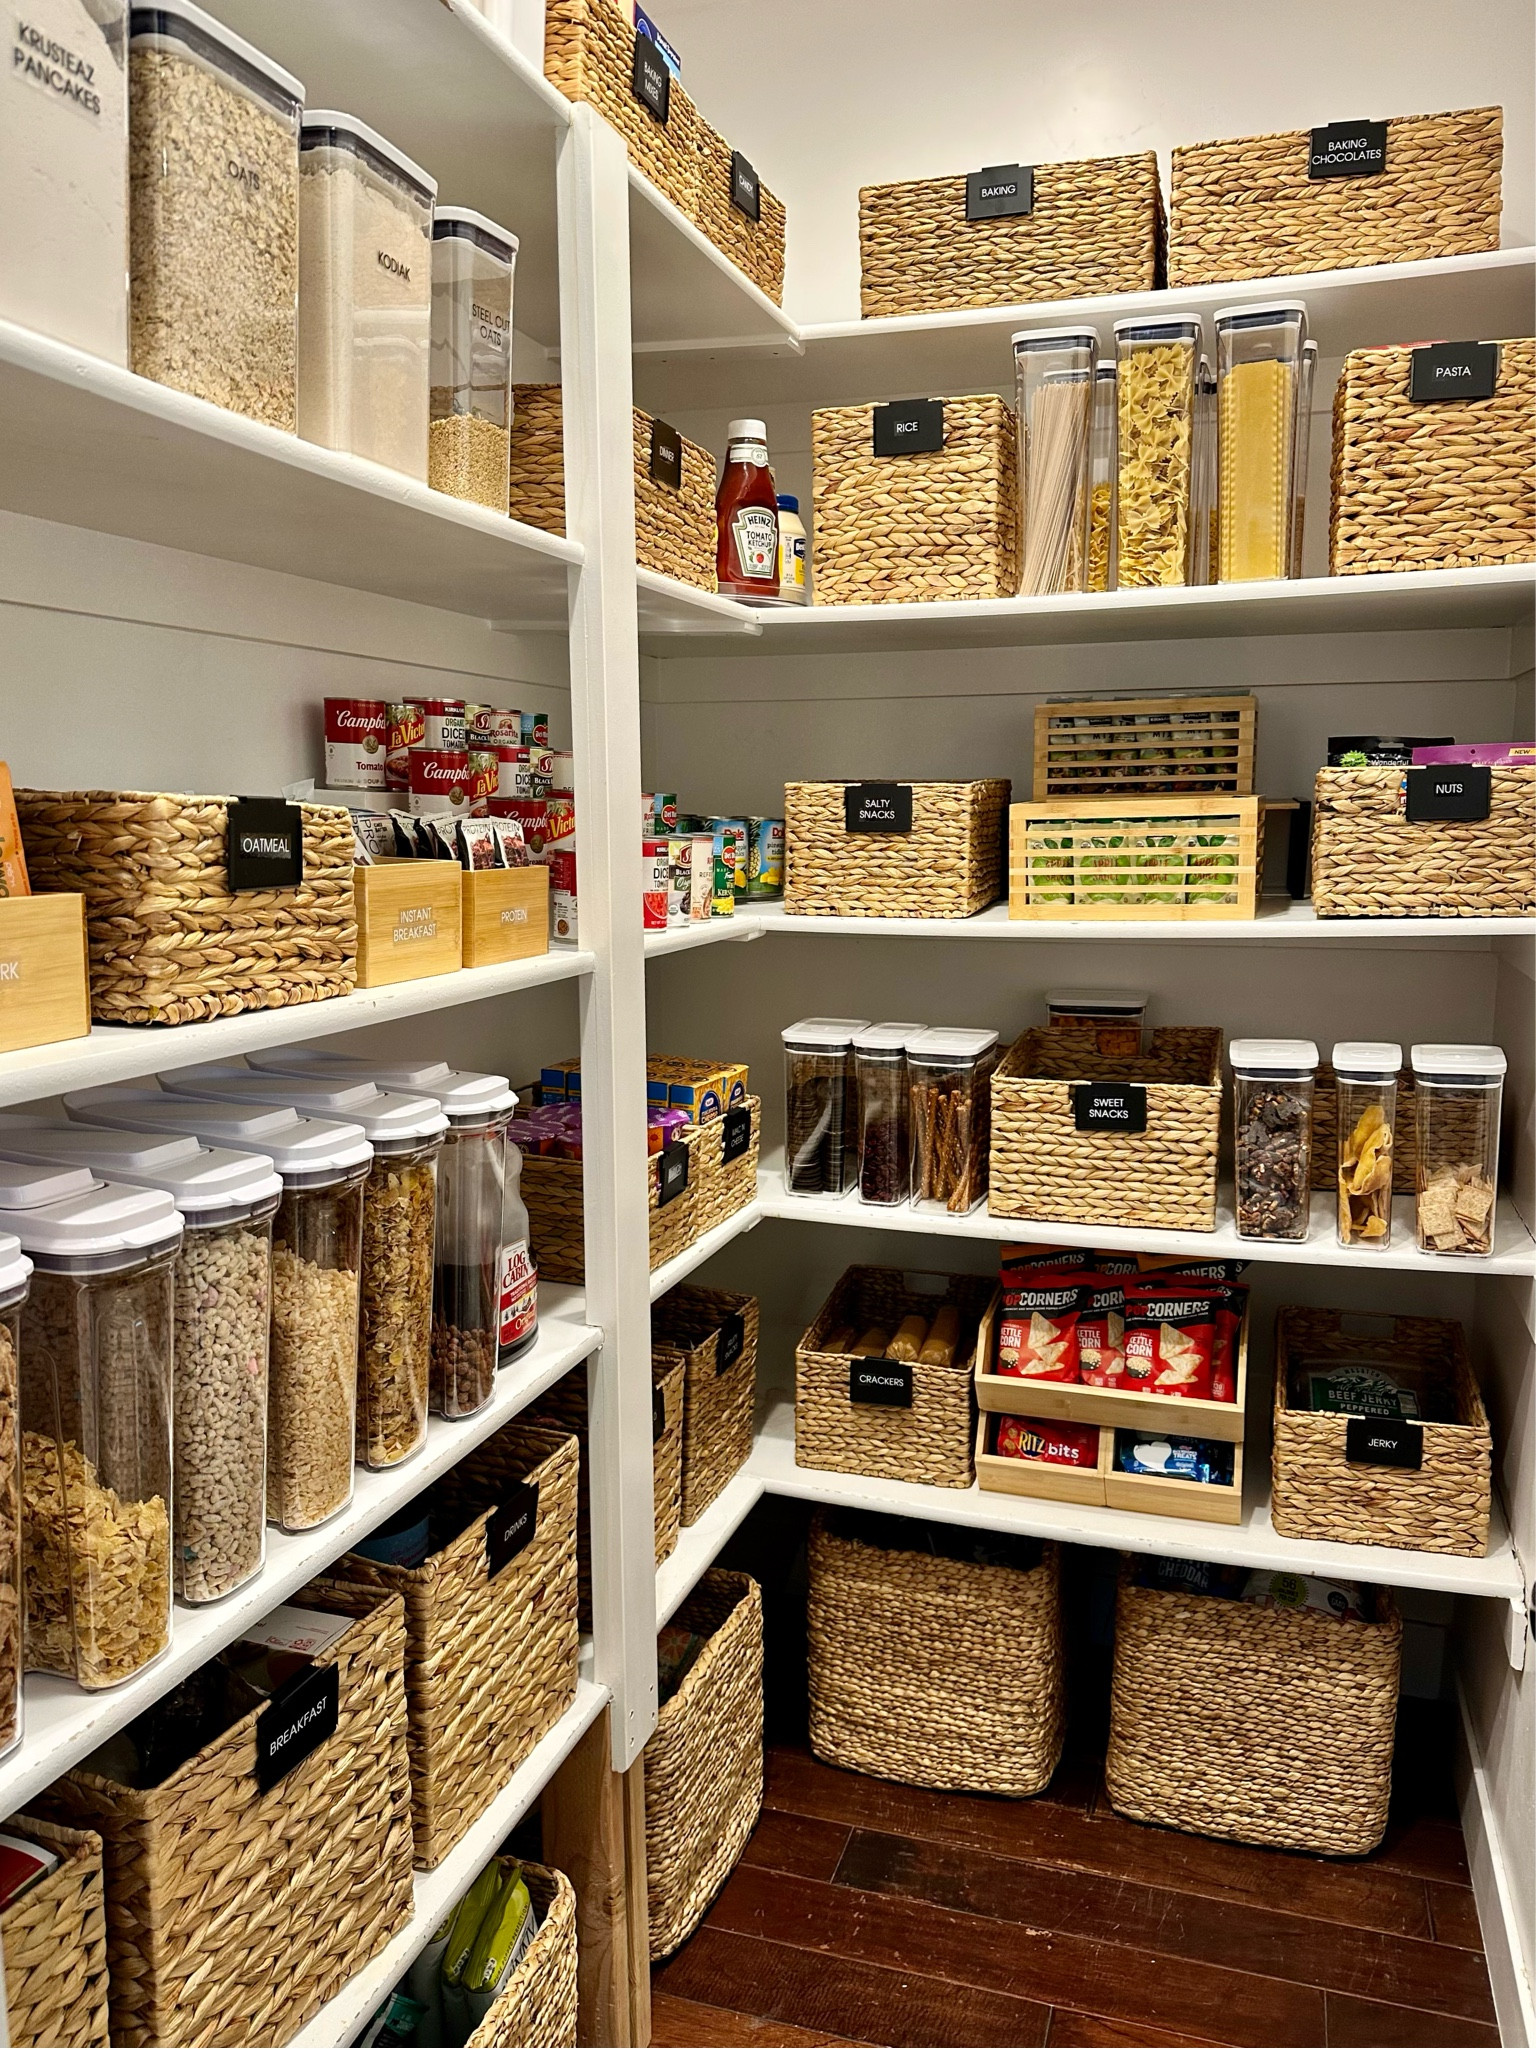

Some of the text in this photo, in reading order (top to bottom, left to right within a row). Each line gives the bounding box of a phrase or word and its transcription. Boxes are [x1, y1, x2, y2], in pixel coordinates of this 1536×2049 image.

[18, 21, 95, 87] KRUSTEAZ
[14, 46, 101, 115] PANCAKES
[644, 61, 662, 88] BAKING
[1328, 138, 1368, 152] BAKING
[1312, 149, 1382, 165] CHOCOLATES
[228, 160, 260, 190] OATS
[981, 184, 1016, 198] BAKING
[376, 250, 411, 282] KODIAK
[472, 303, 511, 333] STEEL CUT
[479, 325, 501, 346] OATS
[1435, 366, 1472, 378] PASTA
[896, 421, 919, 433] RICE
[659, 445, 675, 463] DINNER
[747, 515, 771, 528] HEINZ
[746, 530, 773, 542] TOMATO
[748, 540, 772, 549] KETCHUP
[356, 761, 384, 771] Tomato
[1435, 783, 1463, 794] NUTS
[865, 799, 891, 808] SALTY
[859, 810, 896, 820] SNACKS
[462, 823, 492, 836] PROTEIN
[242, 837, 290, 853] OATMEAL
[399, 906, 432, 923] INSTANT
[501, 908, 528, 923] PROTEIN
[392, 923, 437, 942] BREAKFAST
[1093, 1098, 1124, 1107] SWEET
[1088, 1109, 1129, 1119] SNACKS
[508, 1250, 526, 1273] LOG
[502, 1263, 529, 1289] CABIN
[1125, 1301, 1211, 1318] POPCORNERS
[1126, 1344, 1153, 1358] CORN
[859, 1374, 904, 1387] CRACKERS
[1328, 1389, 1397, 1407] BEEF JERKY
[1340, 1402, 1390, 1416] PEPPERED
[1018, 1430, 1080, 1460] RITZ bits
[1368, 1438, 1398, 1450] JERKY
[504, 1513, 528, 1542] DRINKS
[1157, 1560, 1209, 1590] CHEDDAR
[269, 1695, 328, 1757] BREAKFAST
[512, 1903, 529, 1940] PERFECTION
